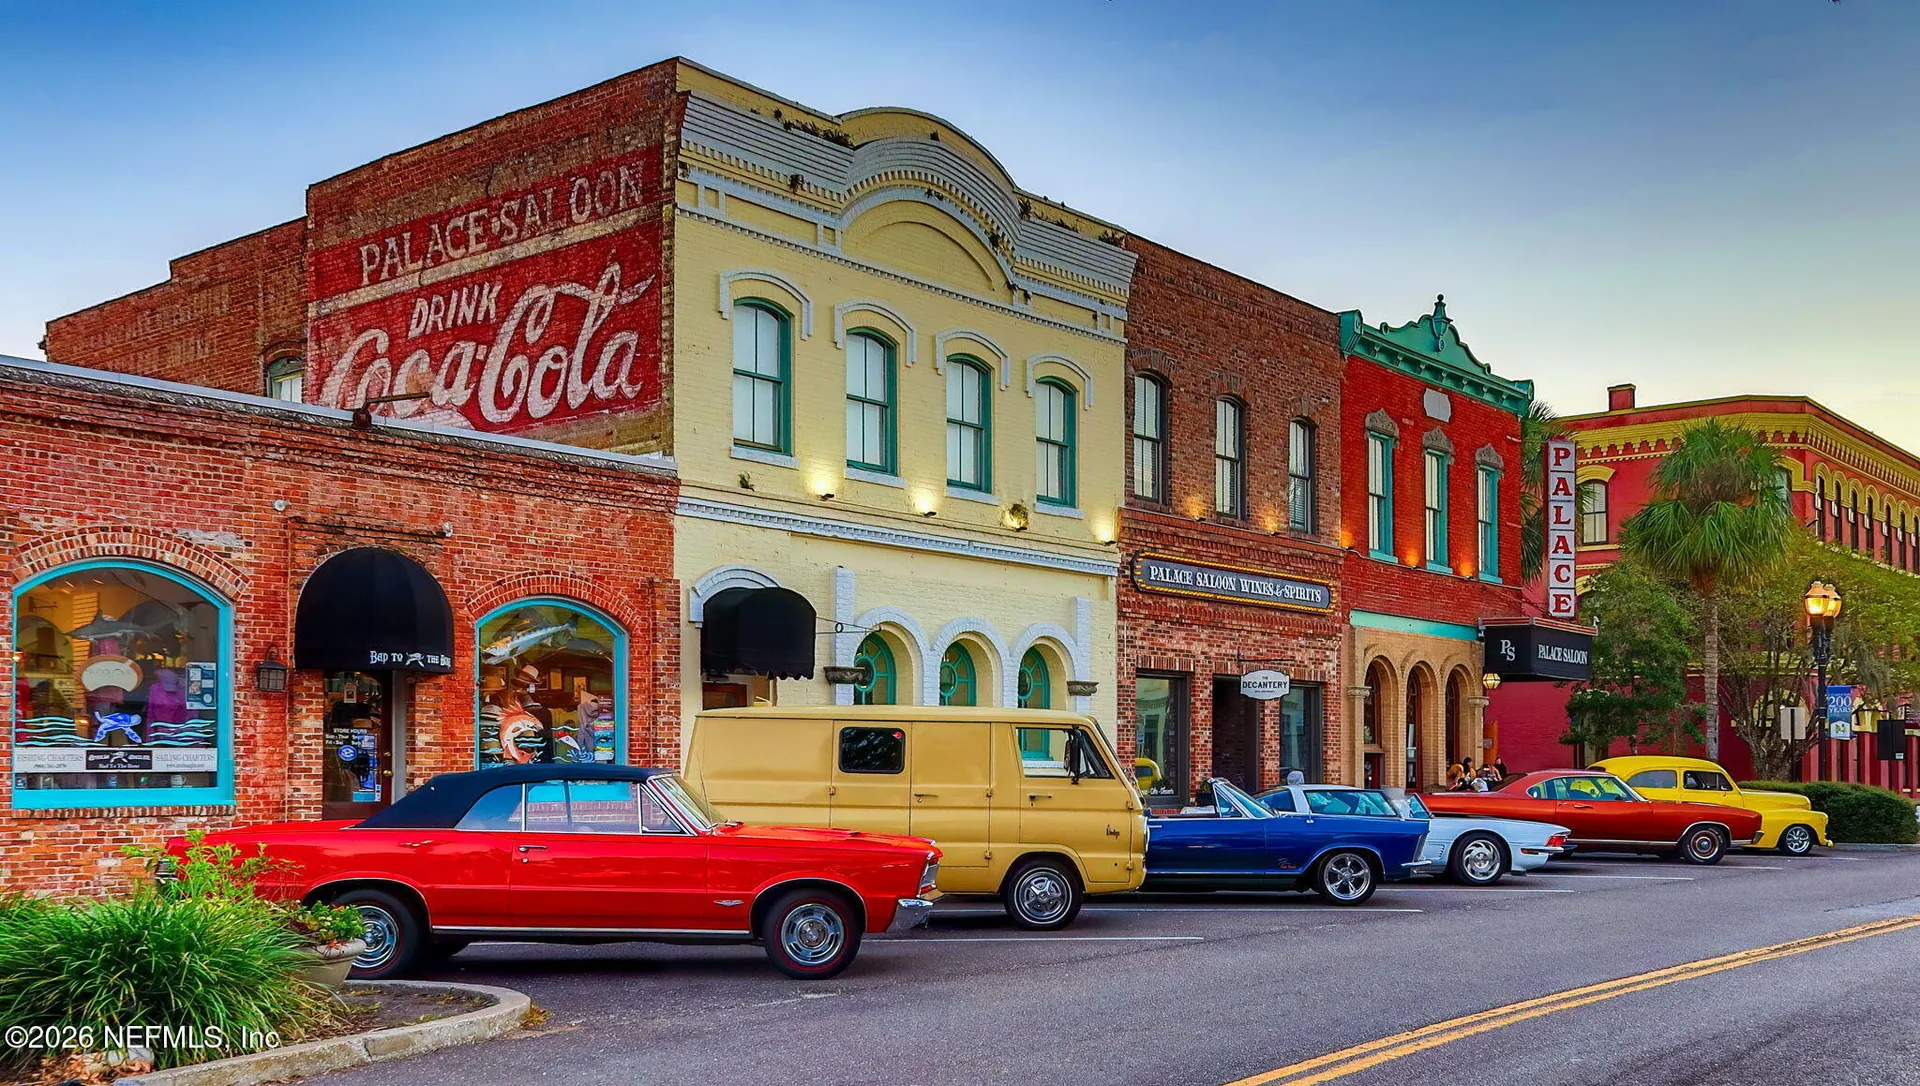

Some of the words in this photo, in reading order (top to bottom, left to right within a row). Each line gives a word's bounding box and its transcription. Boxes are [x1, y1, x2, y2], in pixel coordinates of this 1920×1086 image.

[359, 207, 489, 287] PALACE
[500, 160, 645, 242] SALOON
[407, 282, 504, 340] DRINK
[1551, 447, 1573, 614] PALACE
[1149, 565, 1193, 586] PALACE
[1196, 572, 1236, 592] SALOON
[1239, 578, 1274, 597] WINES
[1273, 585, 1285, 596] &
[1284, 584, 1322, 603] SPIRITS
[1538, 644, 1563, 662] PALACE
[1563, 647, 1588, 665] SALOON
[1242, 681, 1288, 689] DECANTERY
[1828, 695, 1852, 707] 200
